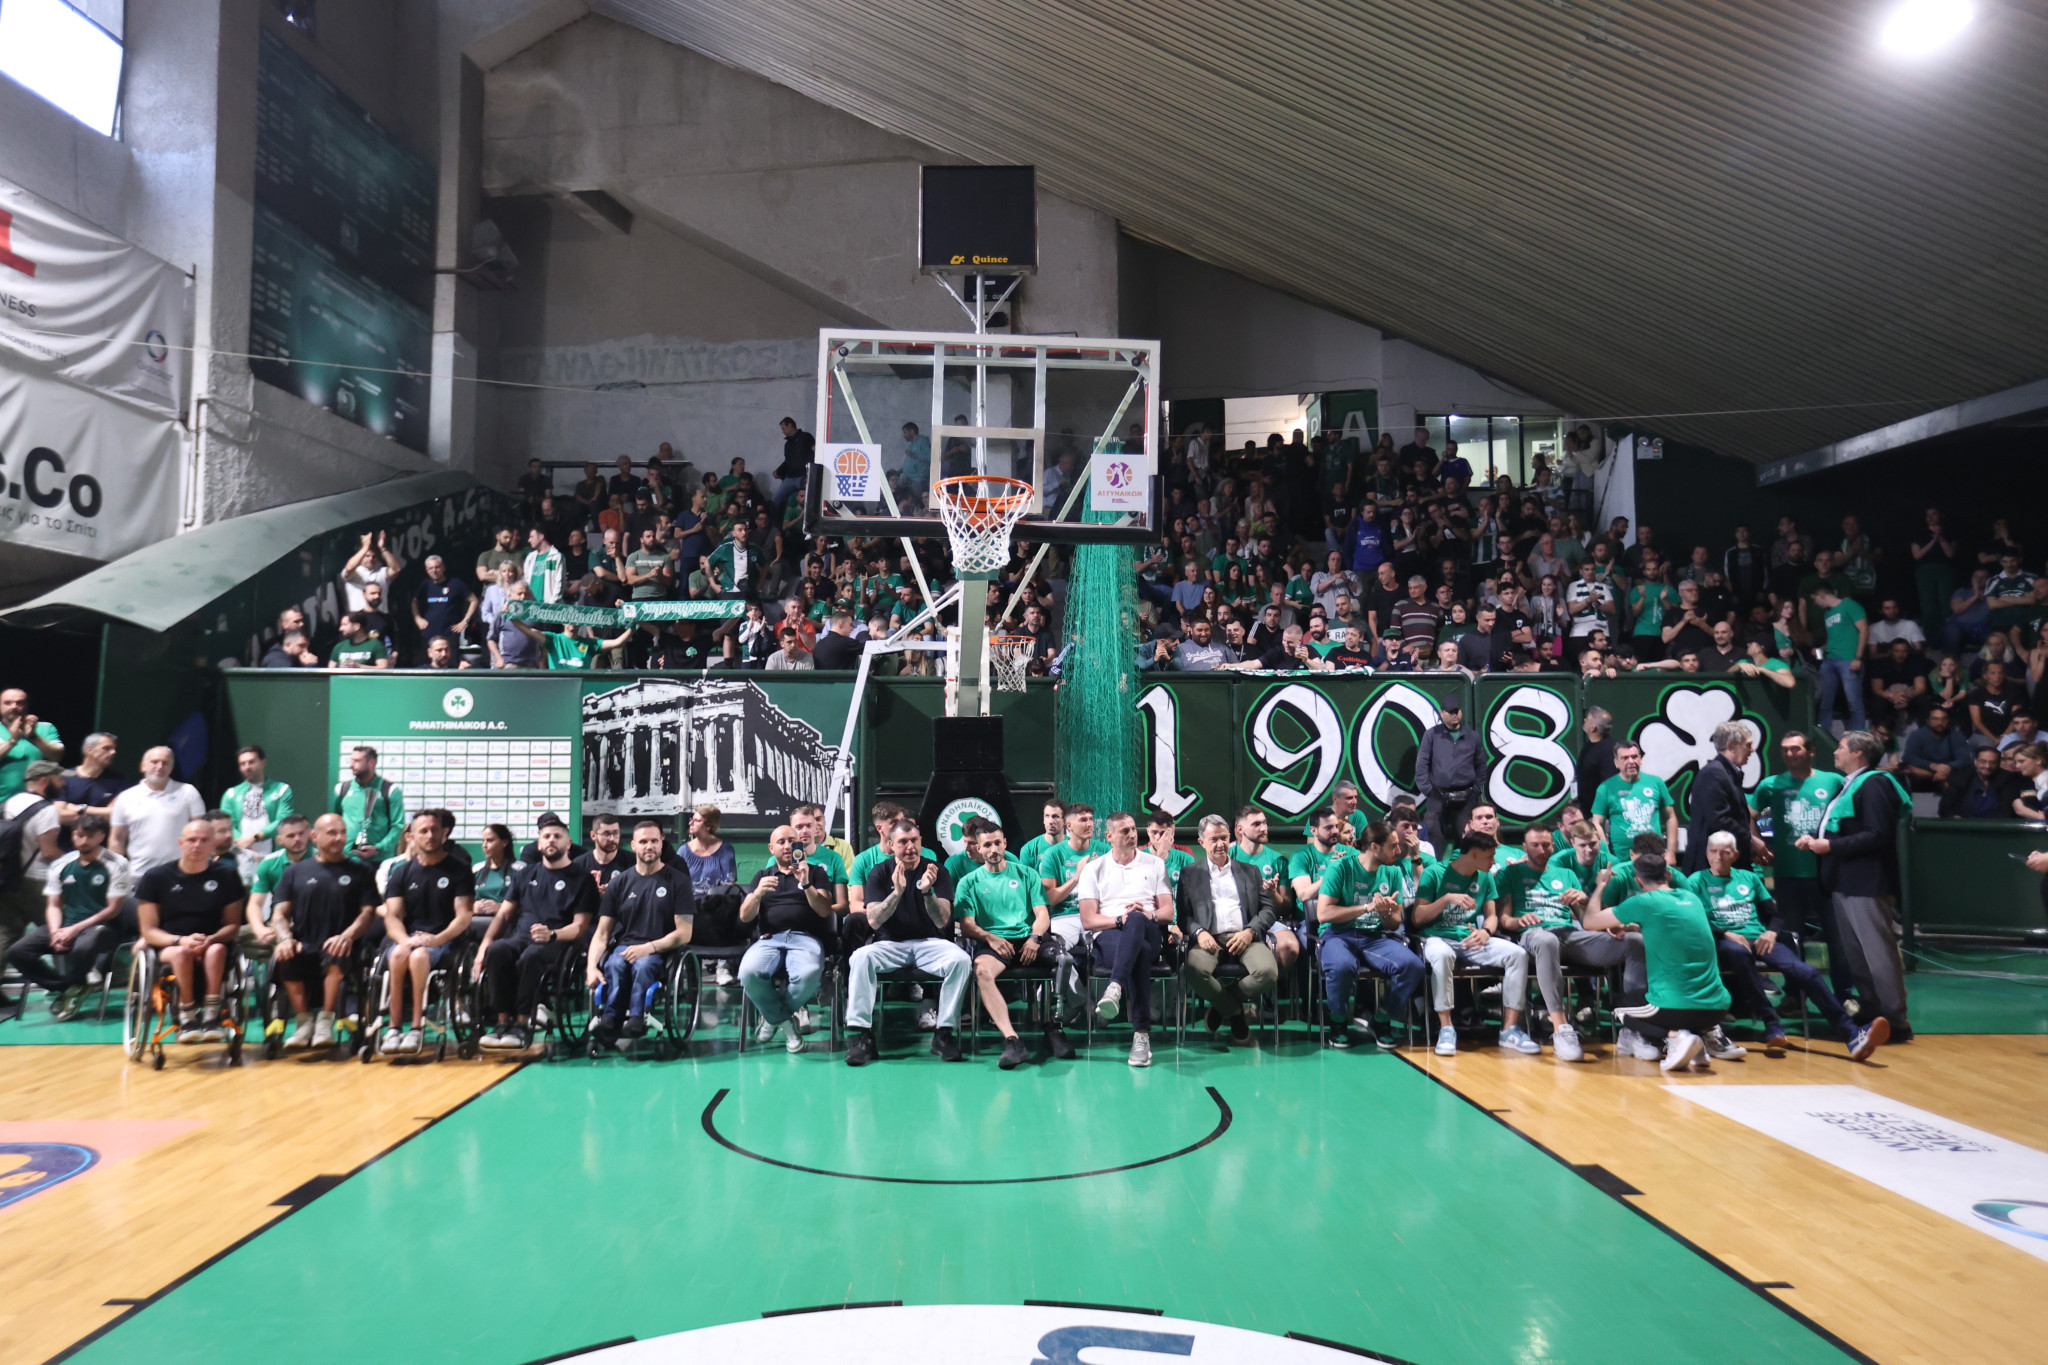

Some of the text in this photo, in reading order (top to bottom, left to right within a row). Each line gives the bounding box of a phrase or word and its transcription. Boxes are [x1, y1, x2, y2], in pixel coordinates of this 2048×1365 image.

[972, 255, 1008, 265] Quince
[409, 721, 508, 731] PANATHINAIKOS A.C.
[939, 801, 993, 839] ΠΑΝΑΘΗΝΑΪΚΟΣ
